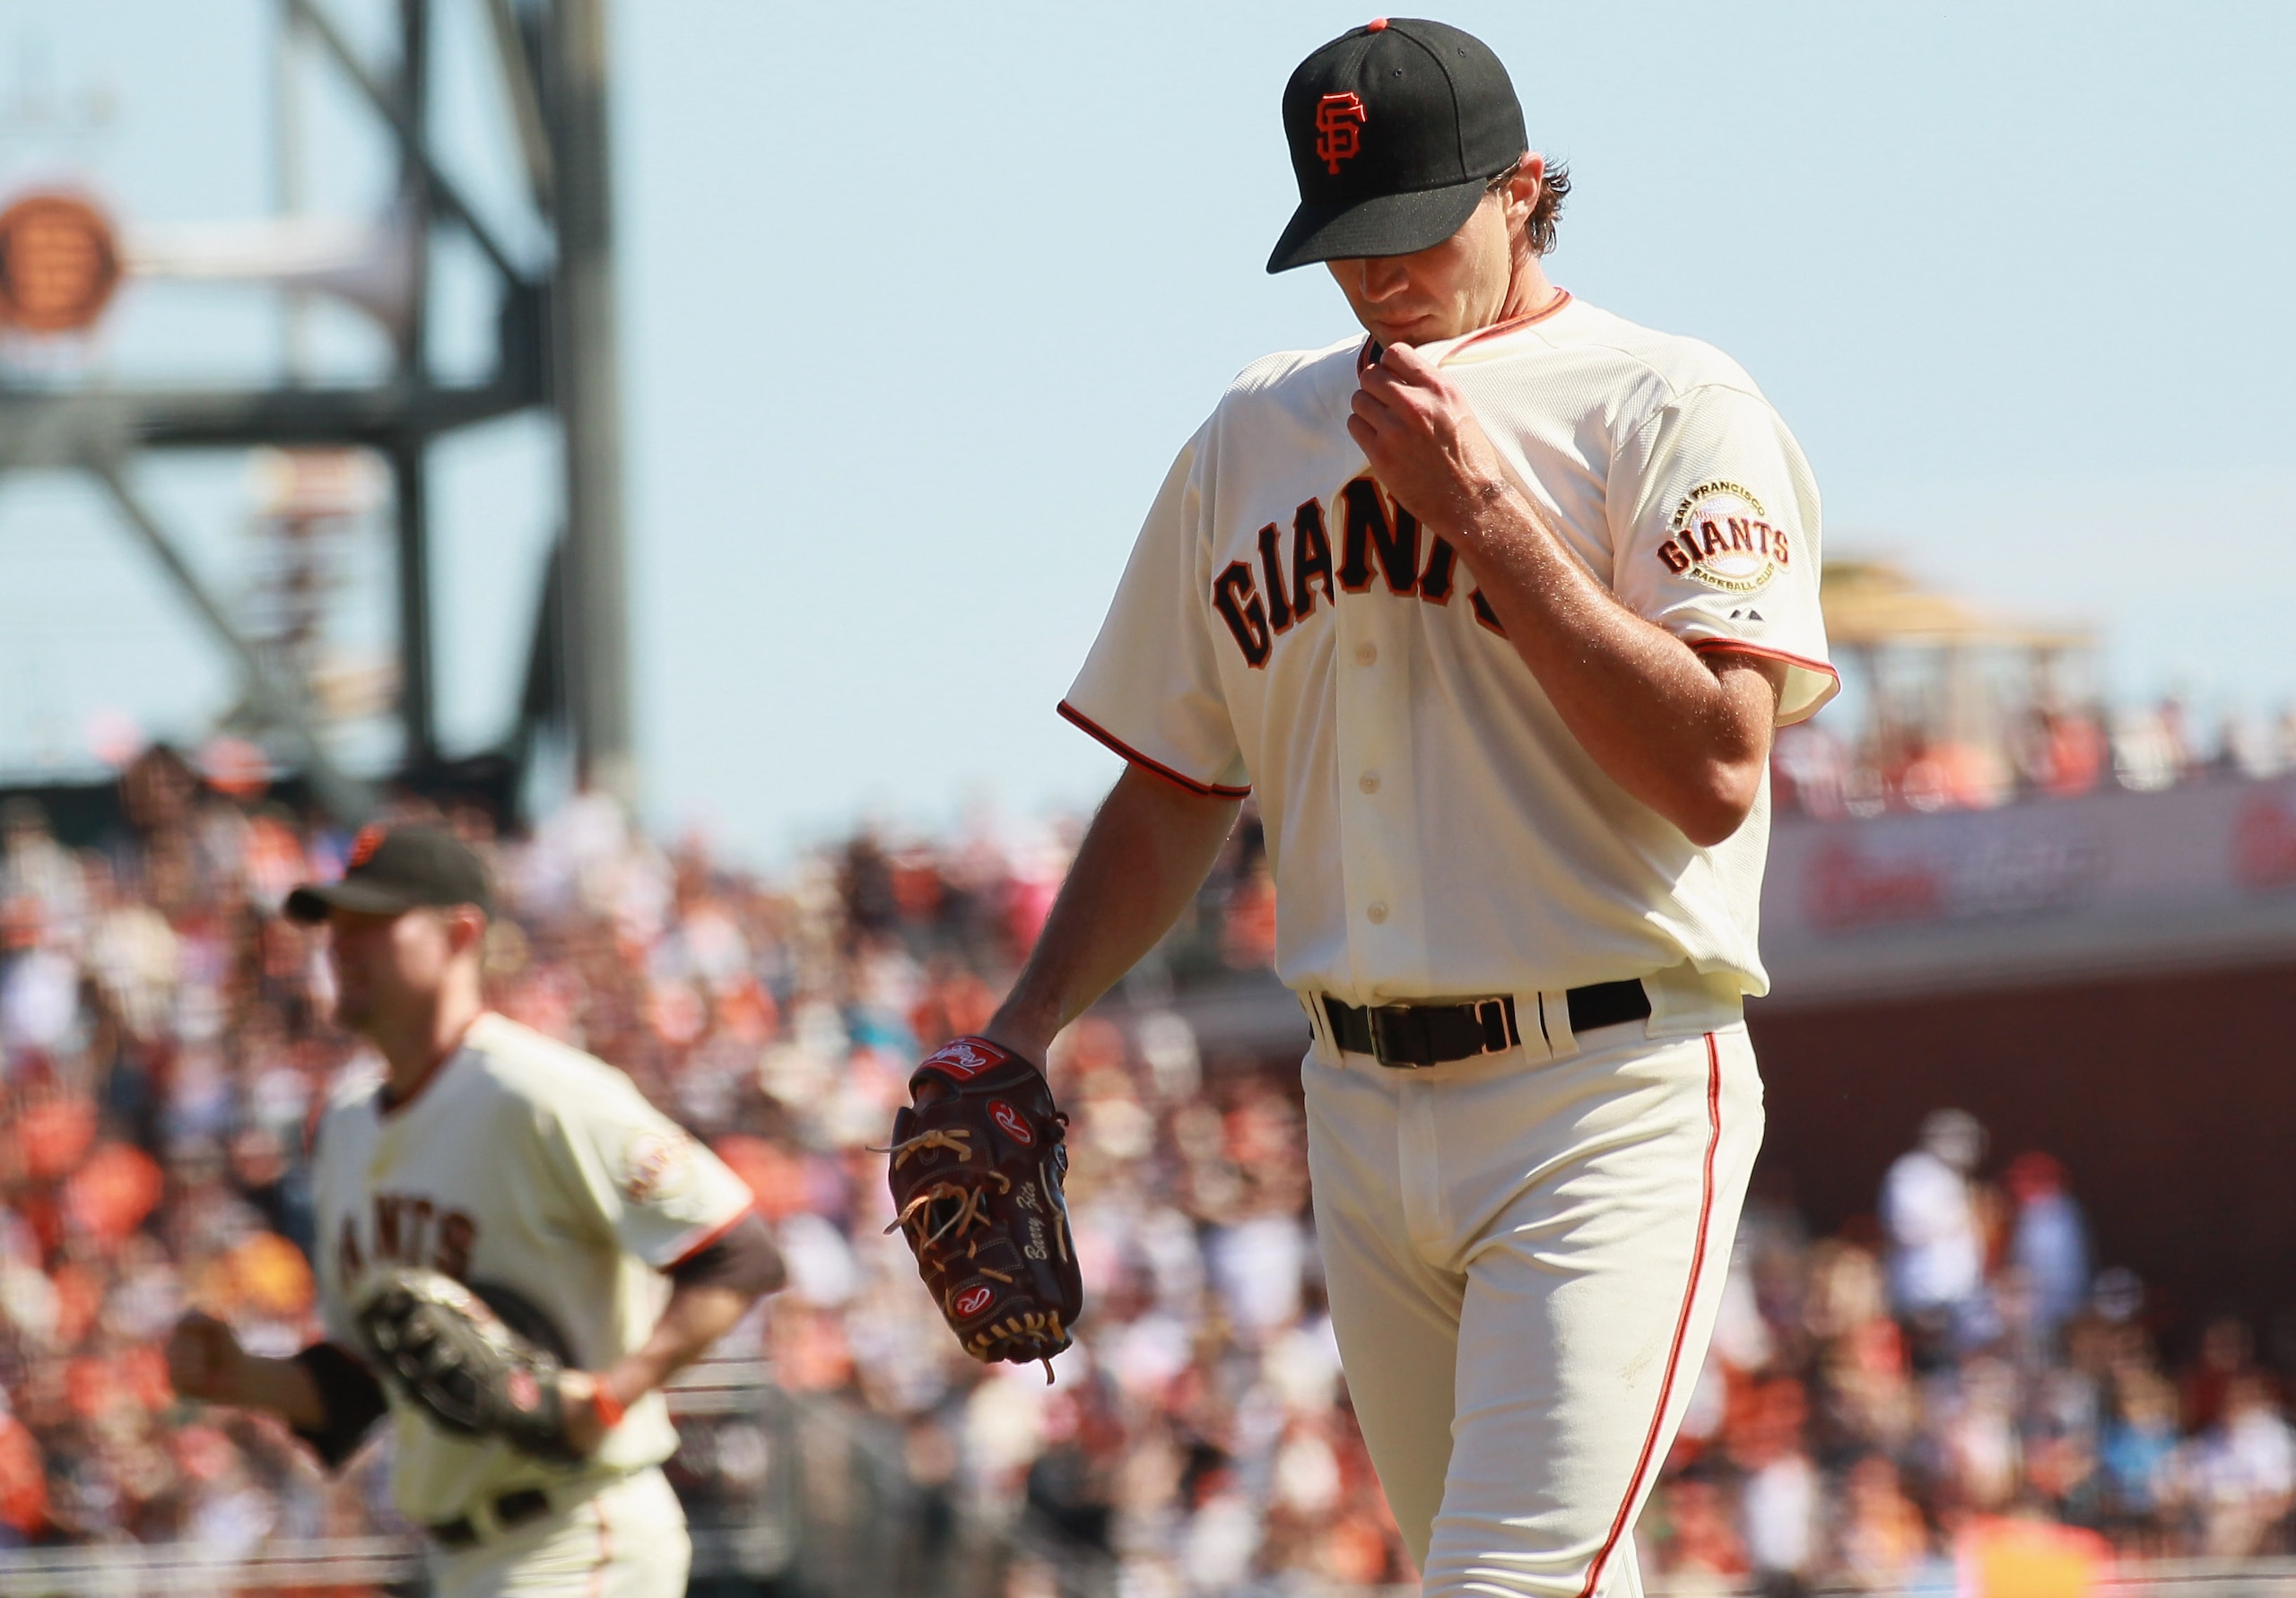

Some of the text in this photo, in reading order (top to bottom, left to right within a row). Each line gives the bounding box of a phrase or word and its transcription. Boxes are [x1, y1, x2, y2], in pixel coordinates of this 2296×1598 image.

[1674, 481, 1766, 526] SAN FRANCISCO
[1657, 517, 1789, 575] GIANTS
[1693, 567, 1756, 591] BASEBALL
[1024, 1216, 1048, 1260] Barry
